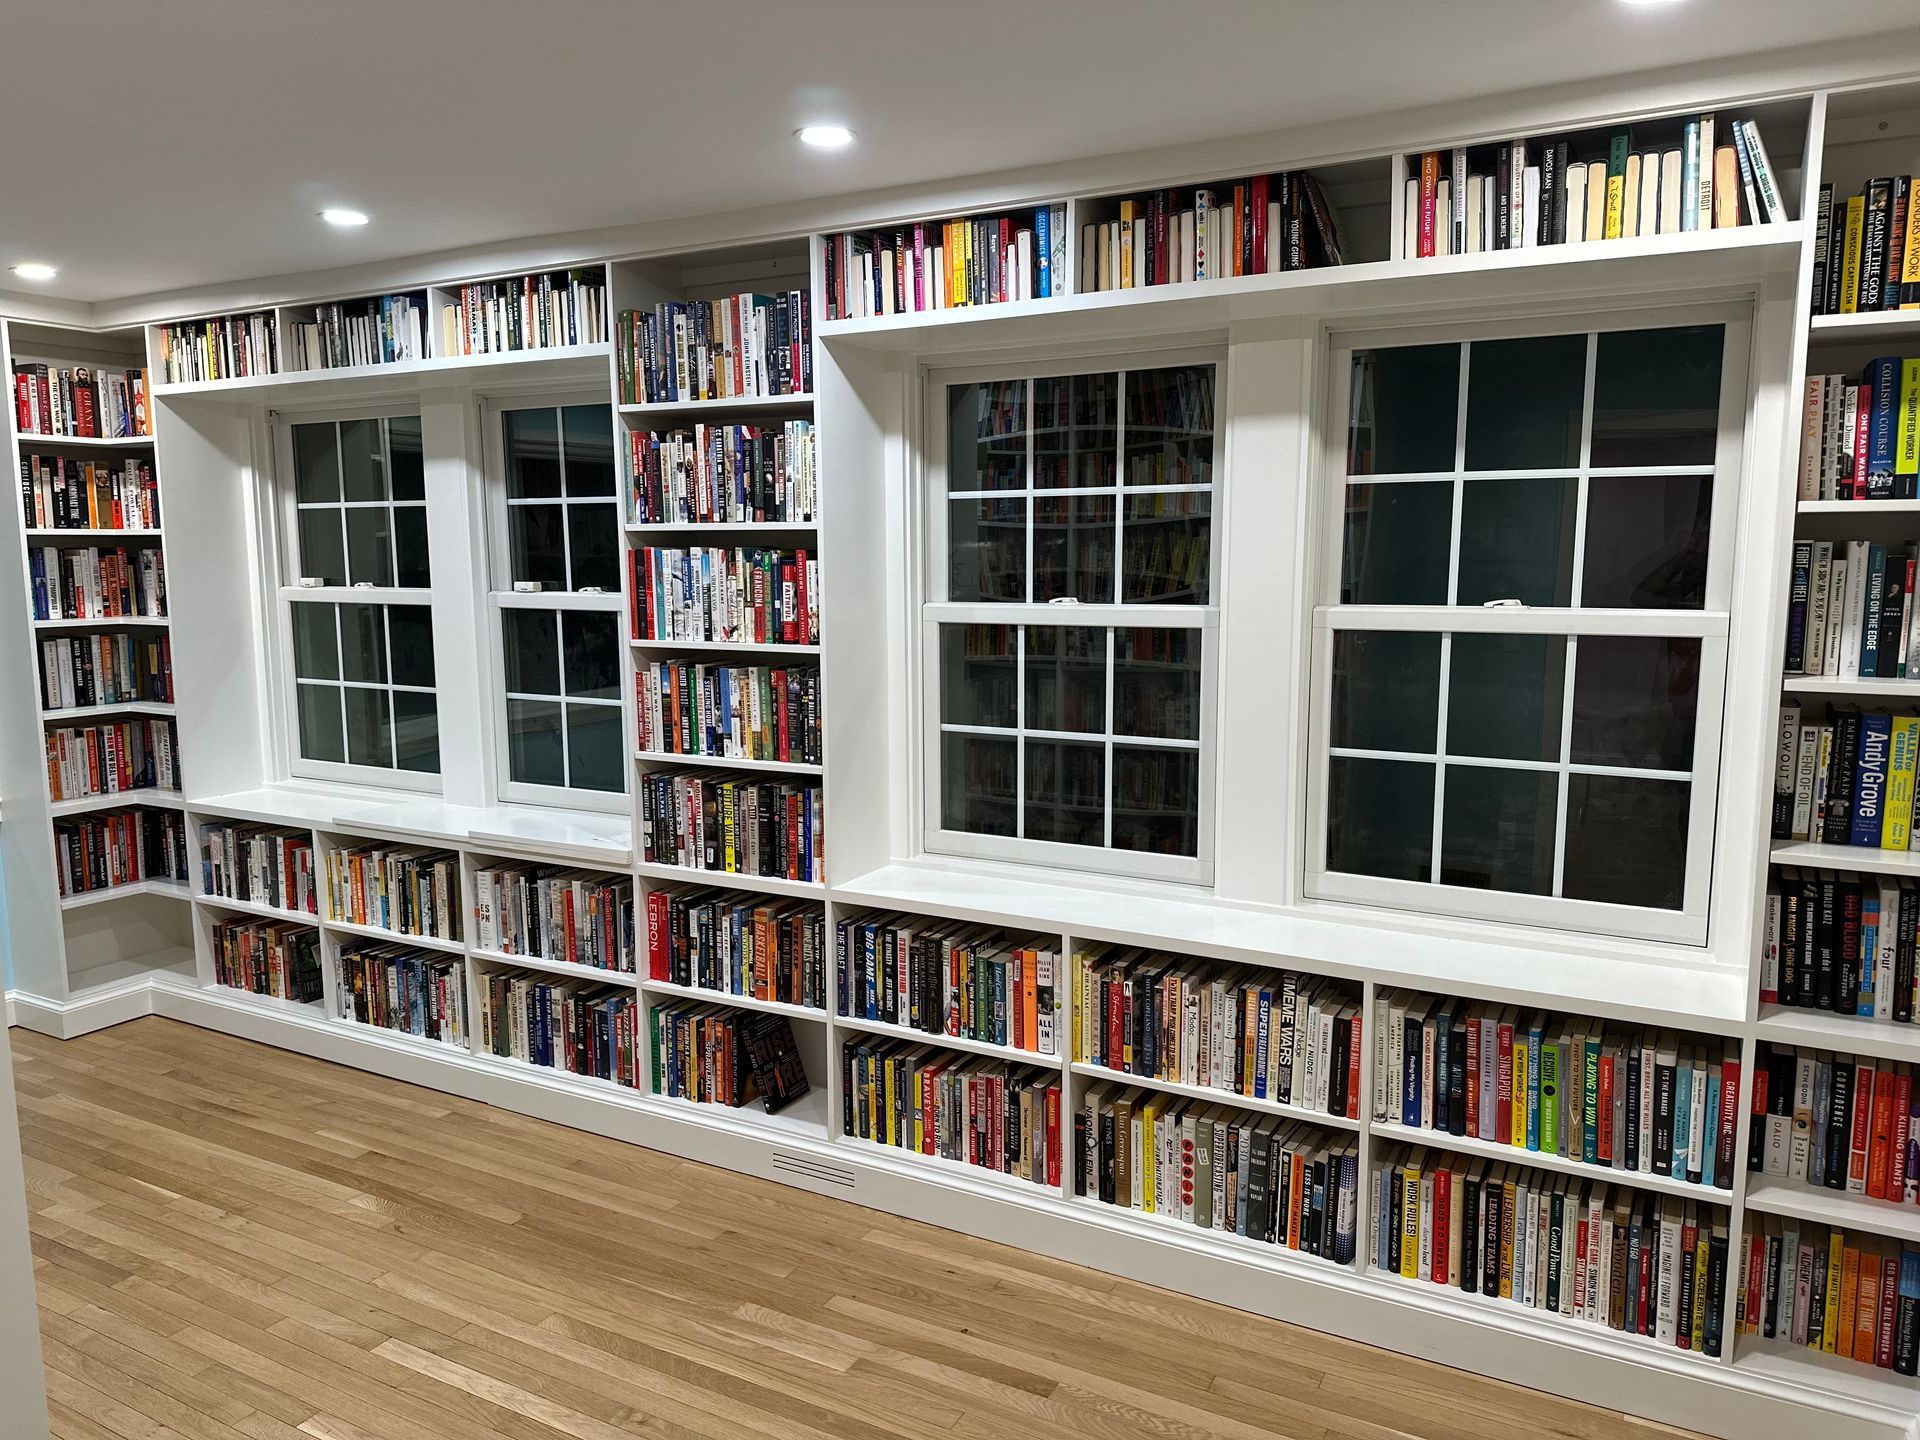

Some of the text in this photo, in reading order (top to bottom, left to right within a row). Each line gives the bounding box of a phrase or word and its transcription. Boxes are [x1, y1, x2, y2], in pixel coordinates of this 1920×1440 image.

[1544, 149, 1553, 189] DAVOS MAN
[1700, 181, 1711, 211] DETROIT
[1290, 219, 1300, 267] YOUNG GUNS
[1814, 190, 1830, 263] BRAVE NEW WORK
[1846, 228, 1858, 305] CONSCIOUS CAPITALISM
[1868, 211, 1885, 304] AGAINST THE GODS
[83, 392, 93, 428] GRANT
[1807, 381, 1819, 438] FAIR PLAY
[1860, 414, 1868, 431] ONE
[1877, 363, 1892, 456] COLLISION COURSE
[1906, 398, 1917, 432] QUANTIFIED
[1905, 434, 1915, 460] WORKER
[21, 462, 30, 494] COOLIDGE
[754, 571, 762, 608] FRANCONA
[1793, 546, 1810, 603] FIGHT HELL
[1866, 573, 1881, 650] LIVING ON THE EDGE
[1779, 715, 1794, 780] BLOWOUT
[1845, 719, 1856, 758] EMPIRE
[1859, 731, 1888, 770] Andy
[1894, 732, 1905, 771] GENIUS
[1905, 723, 1918, 772] VALLEY OF
[1842, 771, 1850, 795] PAIN
[1860, 773, 1885, 817] Grove
[723, 788, 734, 849] FUTURE VALUE
[649, 896, 658, 951] LEBRON
[1768, 897, 1777, 923] sneaker
[1787, 896, 1797, 941] PHIL KNIGHT
[755, 923, 765, 977] BASKETBALL
[837, 931, 845, 945] THE
[865, 931, 874, 982] BIG GAME
[1881, 947, 1894, 971] four
[1785, 947, 1795, 983] SHOE DOG
[1189, 1012, 1197, 1036] Modoc
[1247, 993, 1256, 1036] FREAKONOMICS
[1280, 984, 1294, 1065] MEME WARS
[741, 1030, 766, 1093] RISE AND FIRE
[1257, 1000, 1268, 1078] SUPERFREAKONOMICS
[1294, 1035, 1304, 1057] Nudge
[1306, 1050, 1314, 1076] NUDGE
[1498, 1055, 1511, 1101] SINGAPORE
[1543, 1052, 1555, 1082] DECISIVE
[1573, 1064, 1578, 1072] TO
[923, 1073, 931, 1112] BRAVEY
[1585, 1052, 1597, 1126] PLAYING TO WIN
[1723, 1081, 1735, 1121] CREATIVITY,
[1833, 1071, 1846, 1127] CONFIDENCE
[934, 1125, 940, 1133] TO
[1117, 1110, 1127, 1175] Alan Greenspan
[1239, 1134, 1249, 1161] 2030
[1772, 1122, 1781, 1148] DALIO
[1893, 1115, 1906, 1186] KILLING GIANTS
[1214, 1128, 1224, 1193] SUPERFORECASTING
[1406, 1180, 1417, 1237] WORK RULES!
[1438, 1227, 1444, 1237] TO
[1487, 1198, 1497, 1274] LEADING TEAMS
[1501, 1197, 1513, 1280] LEADERSHIP LINE
[1549, 1226, 1561, 1281] Good Power
[1630, 1238, 1639, 1259] NO EGO
[1575, 1258, 1586, 1305] START WITH WHY
[1587, 1210, 1600, 1308] THE INFINITE GAME SIMON SINEK
[1612, 1242, 1625, 1294] Wooden
[1661, 1252, 1672, 1308] IMAGINE FORWARD
[1799, 1252, 1811, 1284] ALCHEMY
[1885, 1262, 1895, 1298] RED NOTICE
[1696, 1272, 1706, 1320] ACCELERATE
[1881, 1307, 1892, 1352] BILL BROWDER
